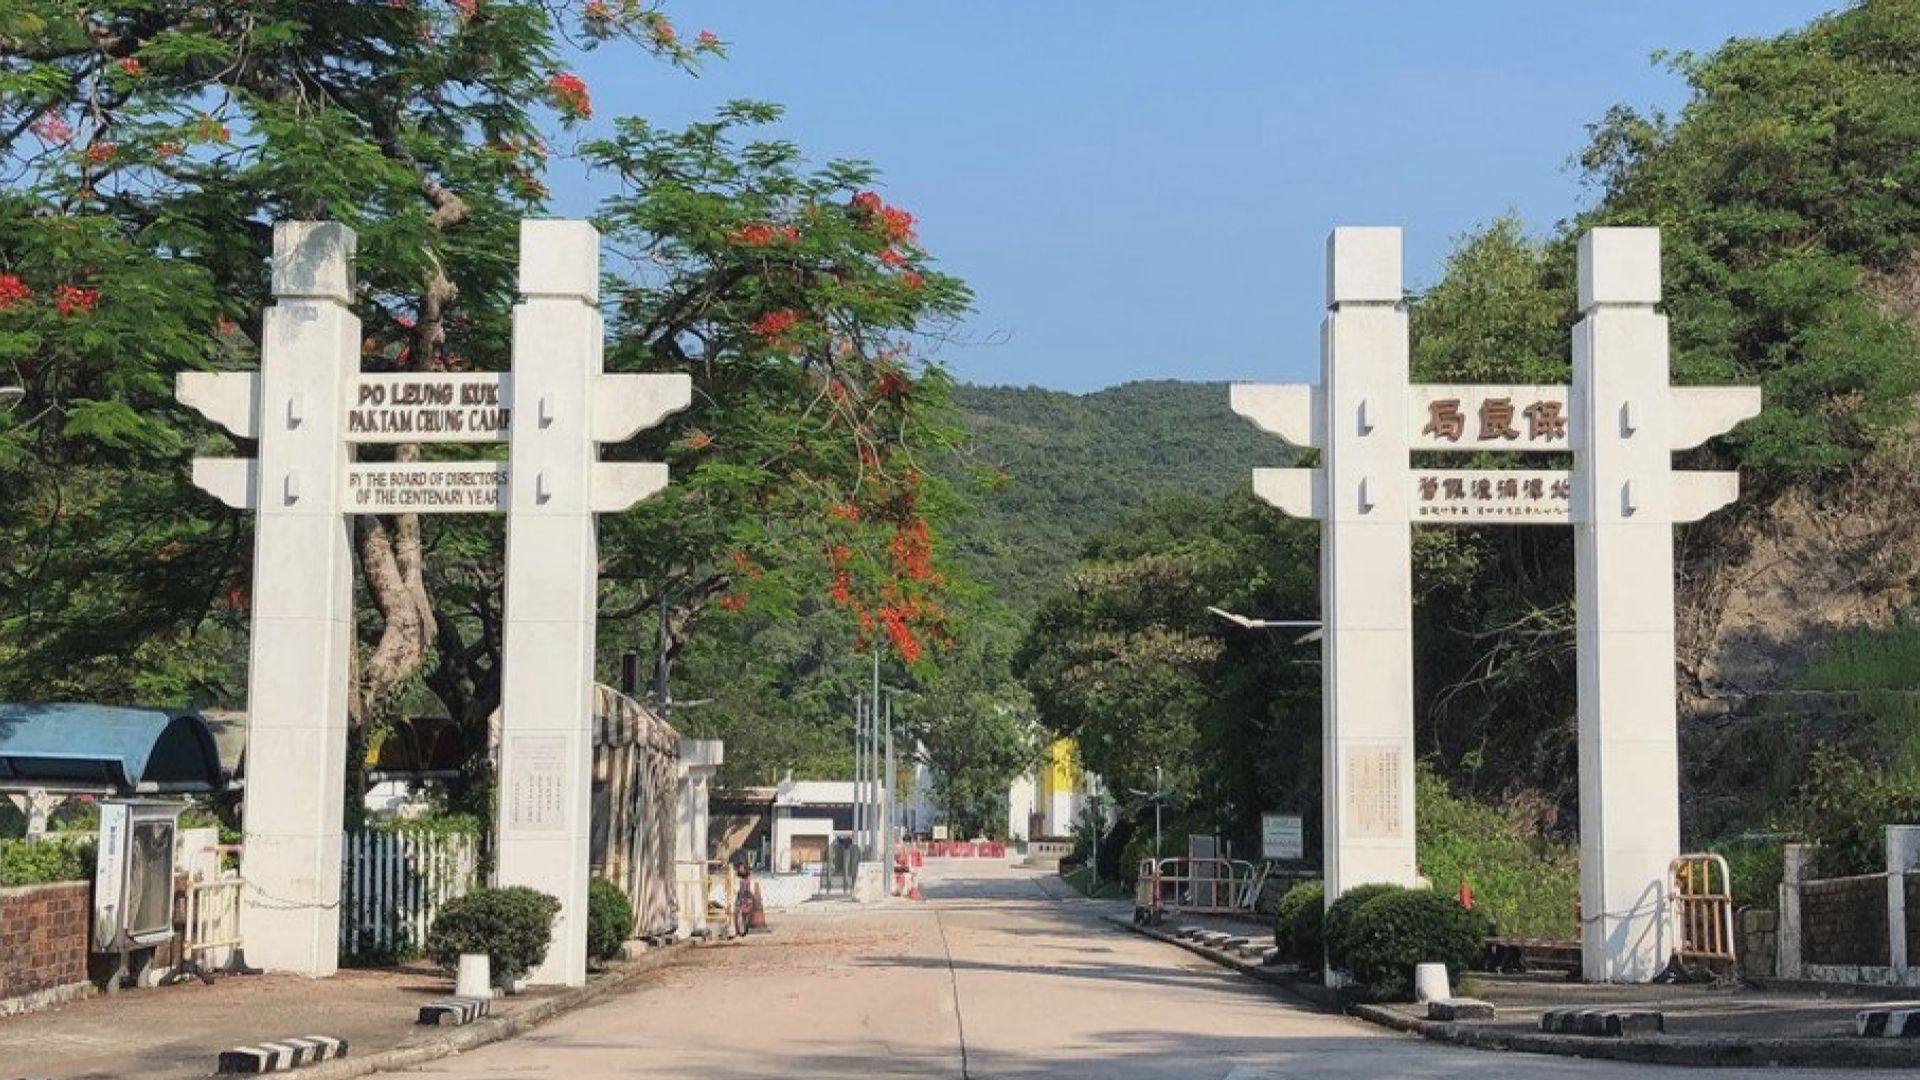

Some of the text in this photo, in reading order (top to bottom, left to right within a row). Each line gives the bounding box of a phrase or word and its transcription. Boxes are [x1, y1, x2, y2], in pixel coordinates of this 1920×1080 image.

[358, 382, 499, 406] PO LEUNG KUK
[416, 409, 463, 432] CHUNG
[1422, 396, 1568, 443] 保良局
[349, 470, 509, 488] BY THE BOARD OF DIRECTORS
[355, 488, 499, 505] OF THE CENTENARY YEAR
